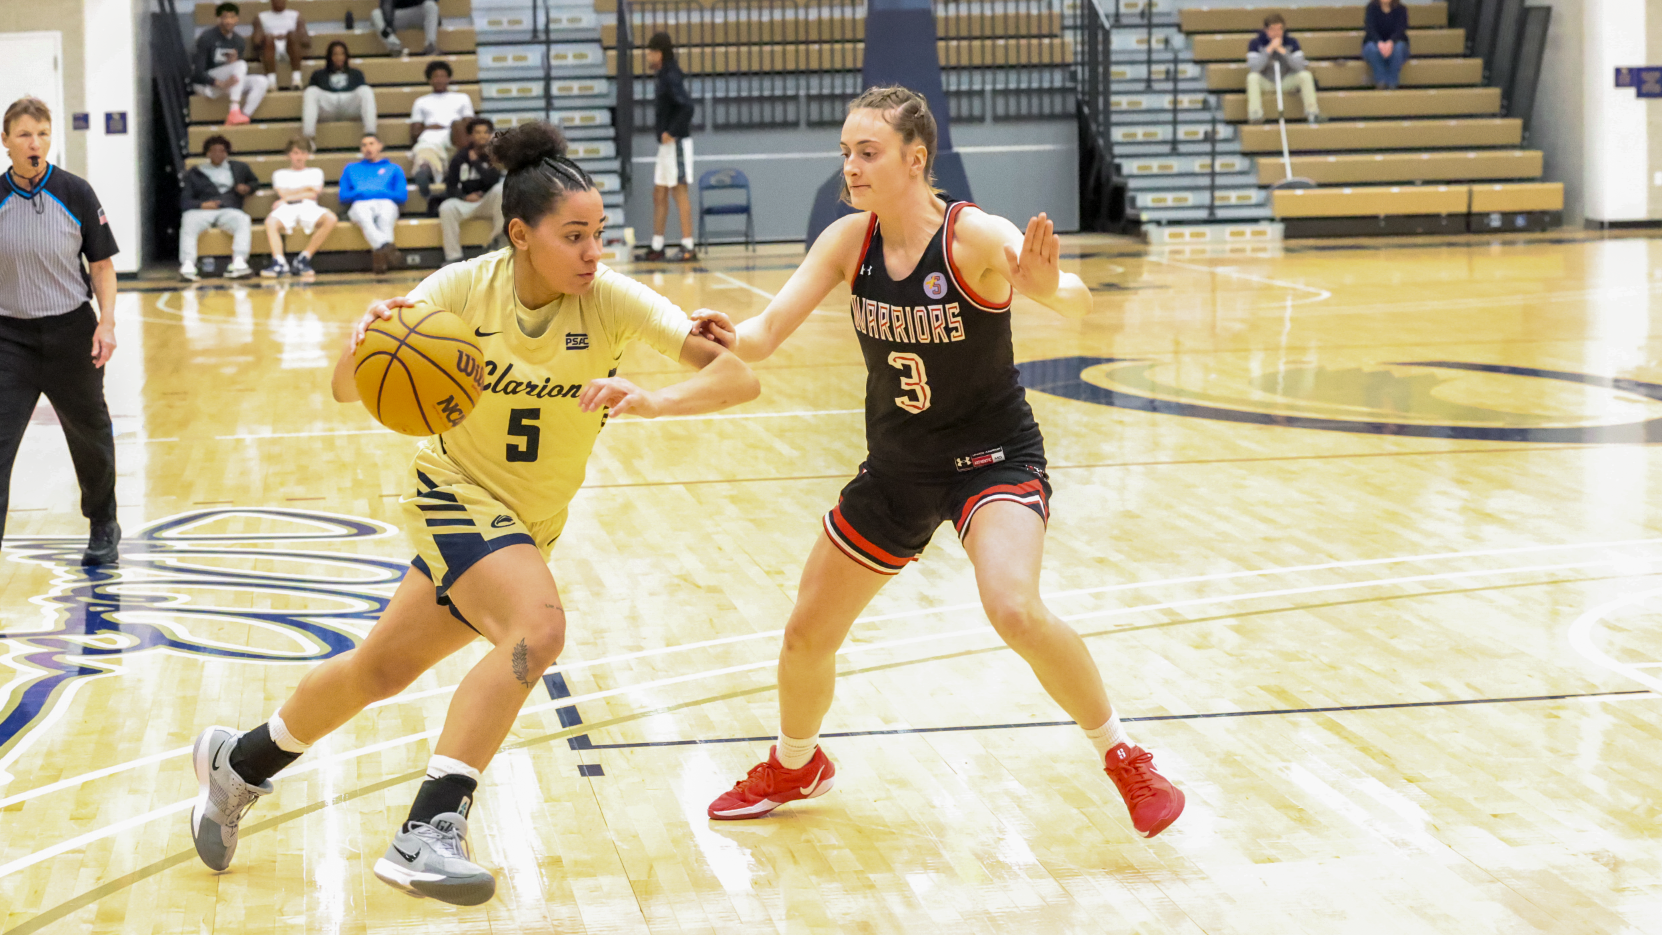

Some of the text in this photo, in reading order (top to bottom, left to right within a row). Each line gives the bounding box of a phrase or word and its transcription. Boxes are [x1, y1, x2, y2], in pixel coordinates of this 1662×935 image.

[851, 294, 966, 343] WARRIORS
[482, 360, 582, 399] Clarion
[887, 350, 931, 414] 3
[506, 407, 541, 463] 5
